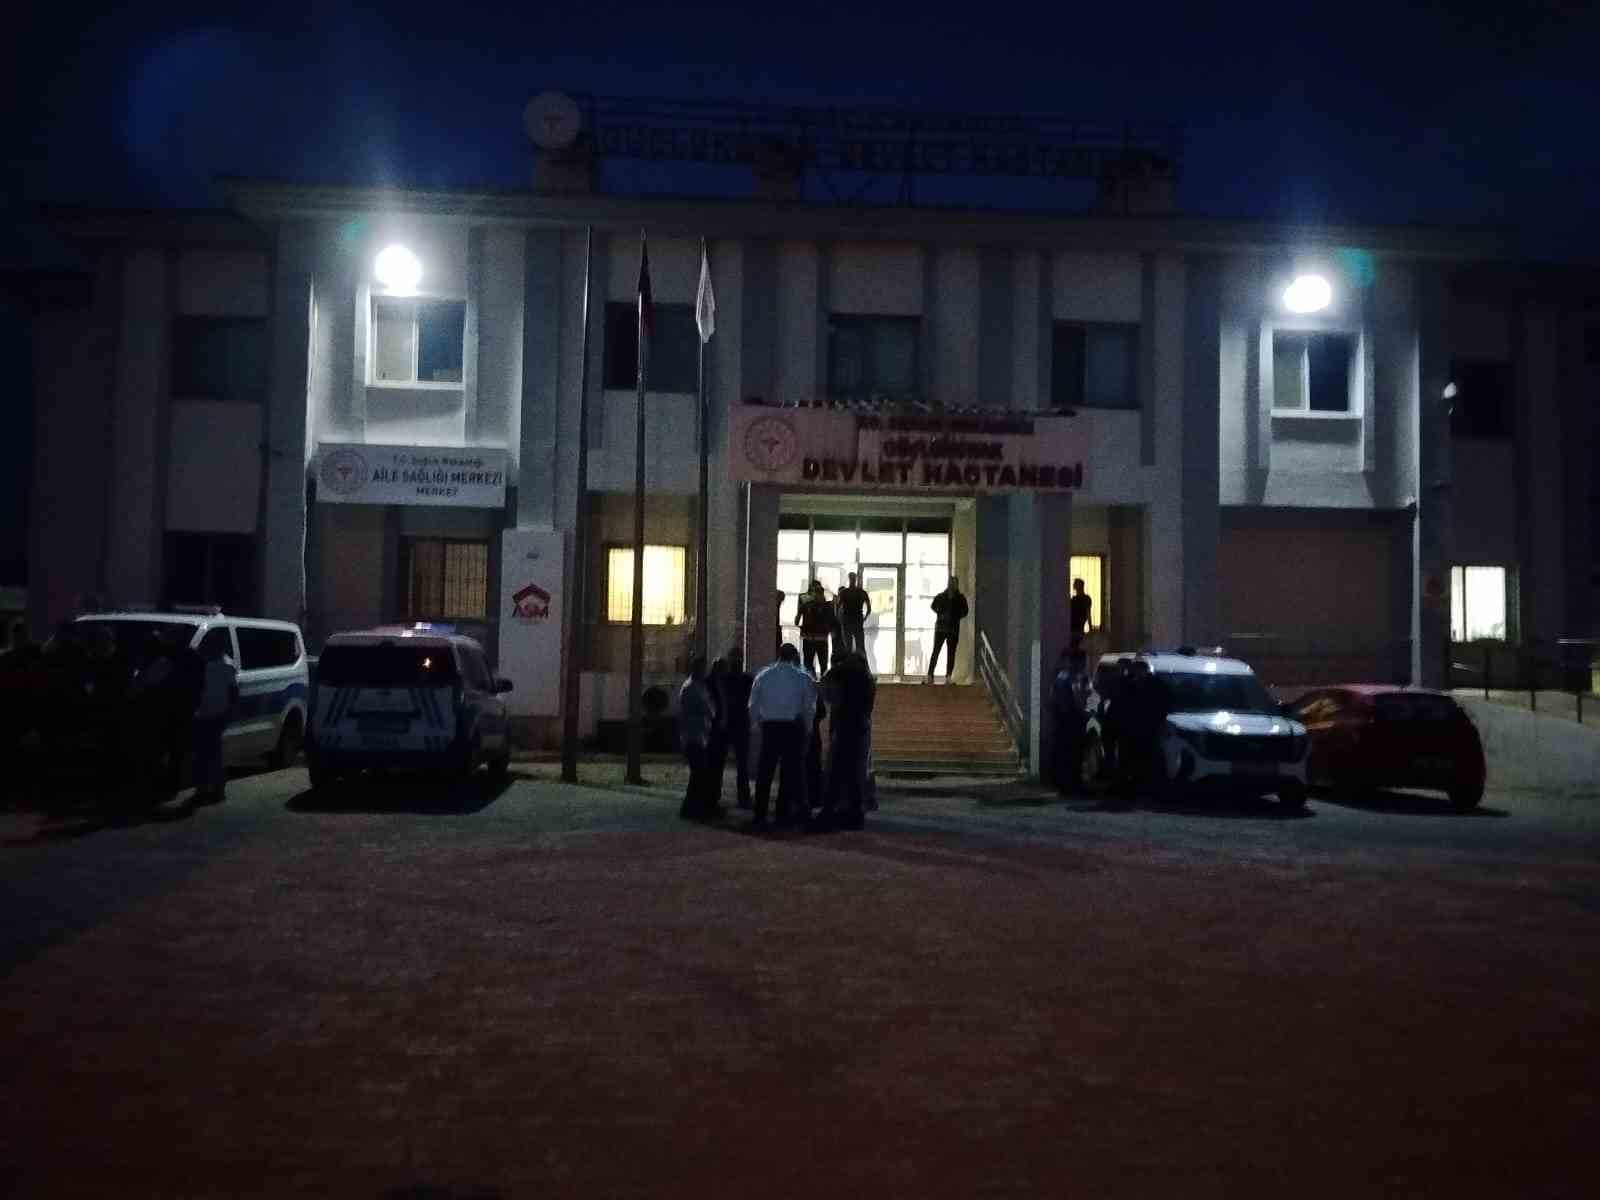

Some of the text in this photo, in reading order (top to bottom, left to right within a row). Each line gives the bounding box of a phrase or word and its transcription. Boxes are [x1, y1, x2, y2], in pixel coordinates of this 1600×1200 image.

[372, 466, 398, 482] AİLE
[402, 468, 448, 485] SAĞLIĞI
[803, 458, 913, 482] DEVLET
